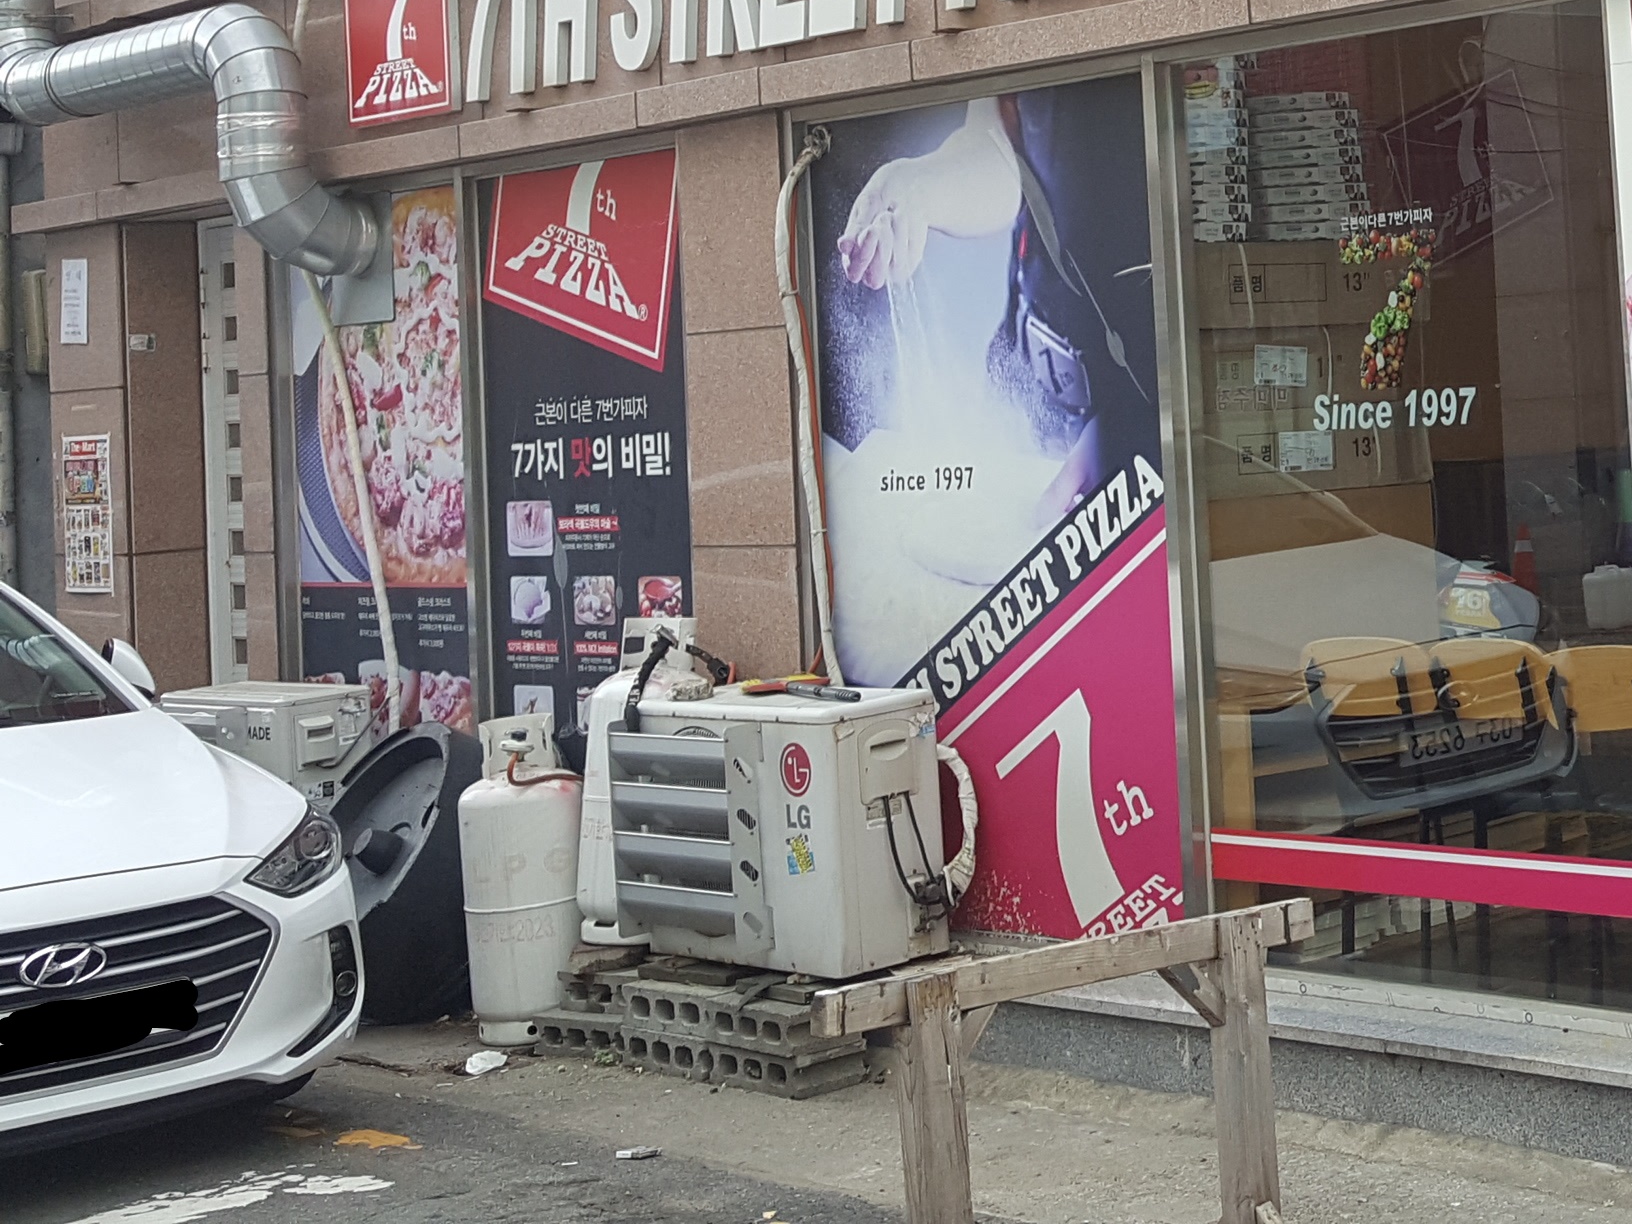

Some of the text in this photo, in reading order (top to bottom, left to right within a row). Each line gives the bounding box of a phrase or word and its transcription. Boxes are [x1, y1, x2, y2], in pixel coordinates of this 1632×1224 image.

[374, 58, 416, 76] STREET
[354, 68, 439, 108] PIZZA
[542, 224, 610, 261] STREET
[504, 236, 640, 319] PIZZA
[534, 395, 647, 425] 근본이 다른 7번가피자
[1313, 395, 1392, 431] Since
[1405, 387, 1476, 426] 1997
[511, 431, 671, 480] 7가지 맛의 비밀!
[880, 467, 974, 491] since 1997
[935, 454, 1164, 700] STREET PIZZA
[786, 804, 811, 829] LG
